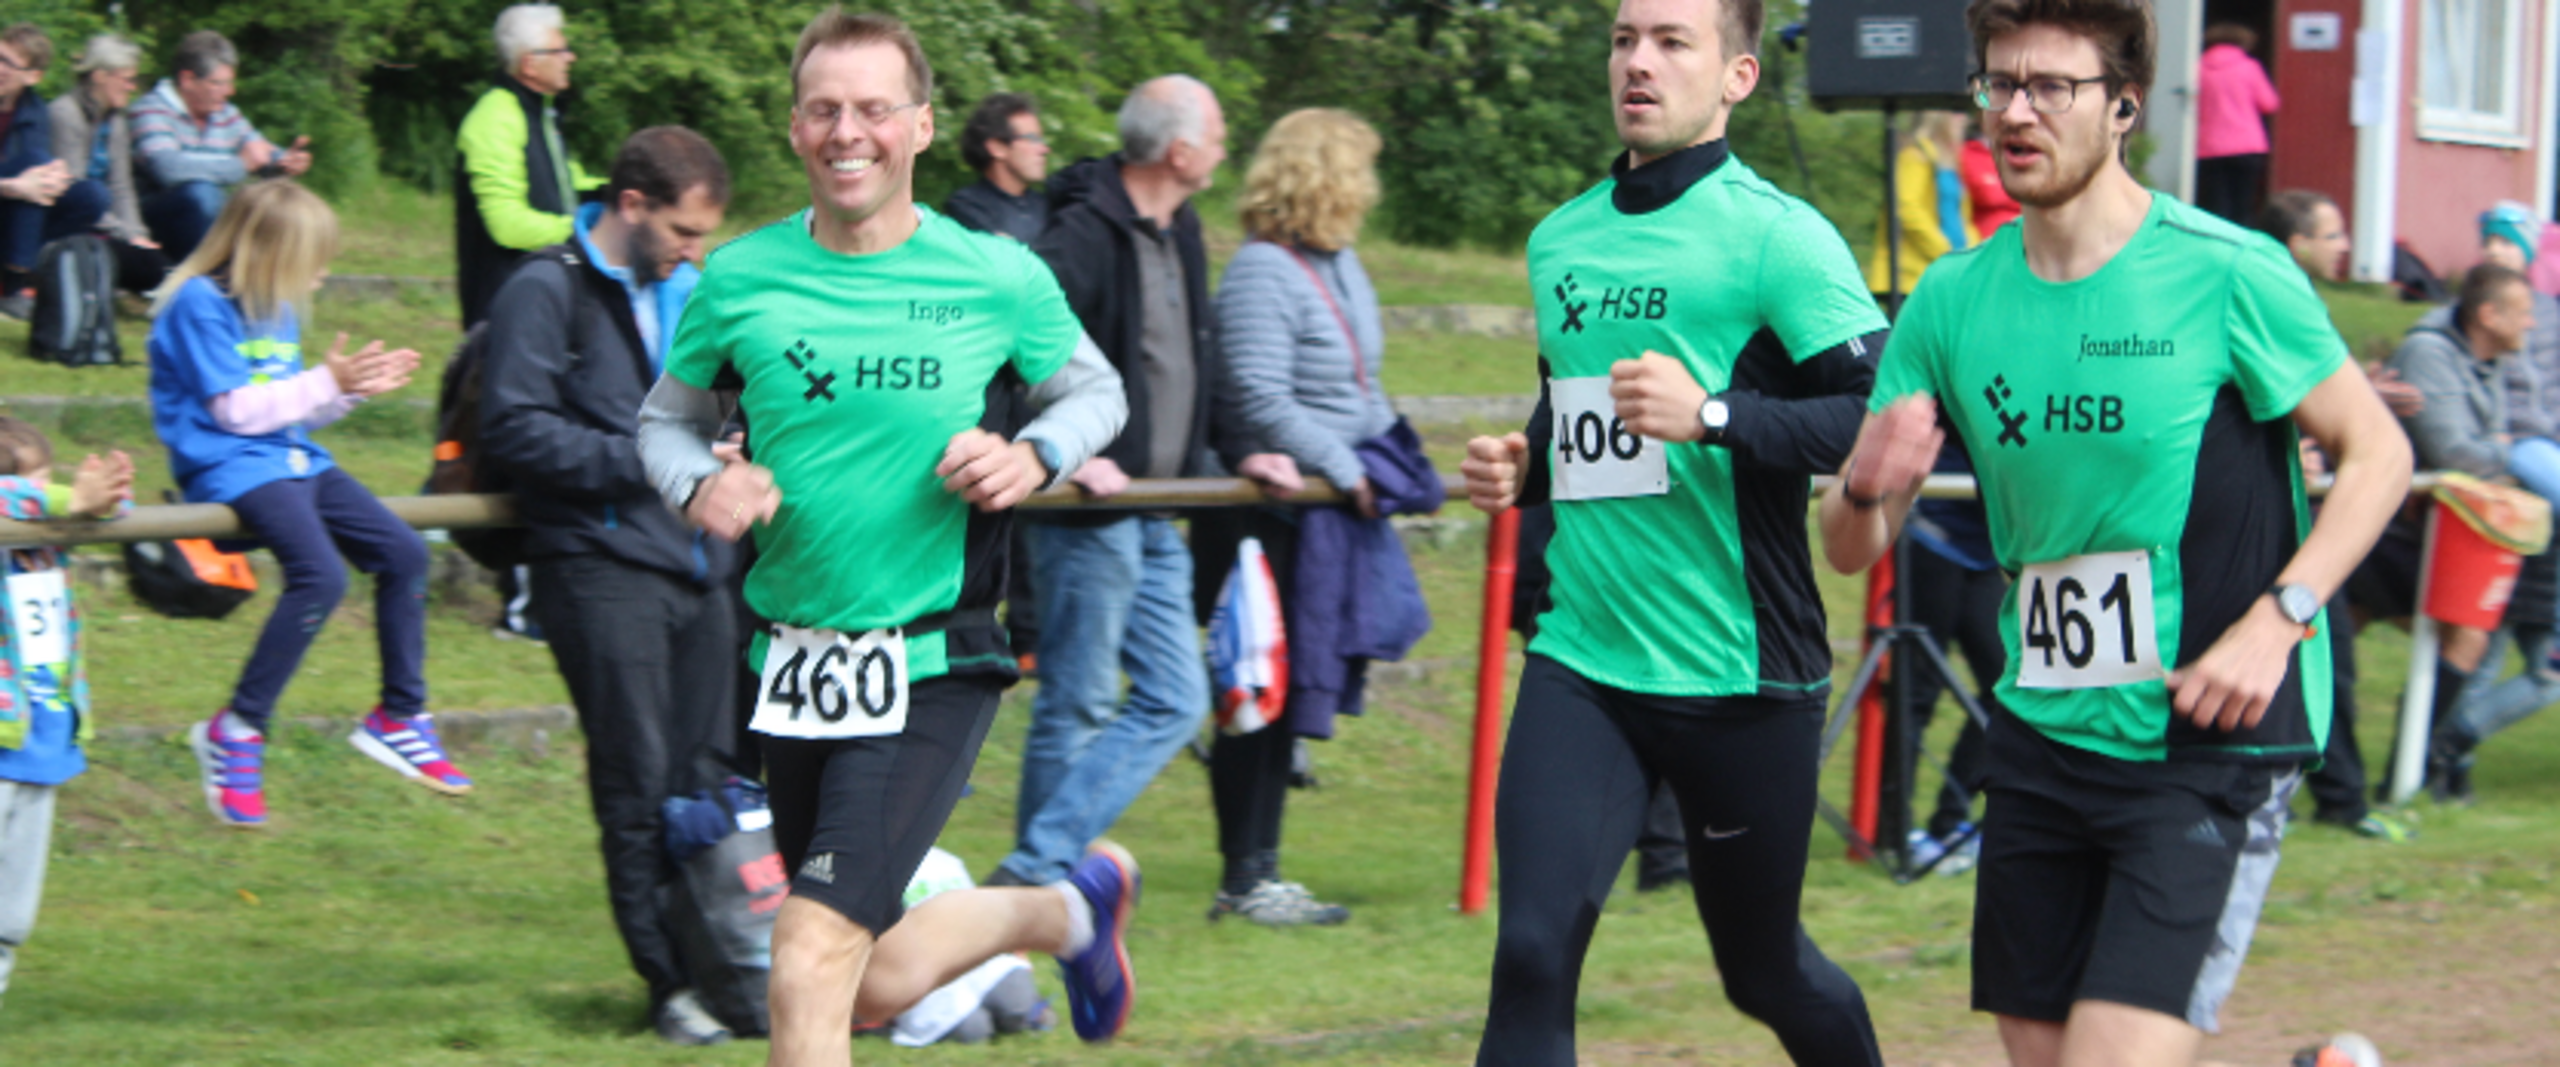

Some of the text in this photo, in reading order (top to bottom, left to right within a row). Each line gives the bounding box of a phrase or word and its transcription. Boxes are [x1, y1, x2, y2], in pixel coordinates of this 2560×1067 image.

[908, 300, 964, 325] Ingo
[1599, 287, 1668, 320] HSB
[2077, 333, 2174, 363] Jonathan
[855, 356, 942, 390] HSB
[2043, 394, 2125, 433] HSB
[1558, 410, 1643, 464] 406
[2026, 571, 2137, 669] 461
[767, 643, 896, 724] 460
